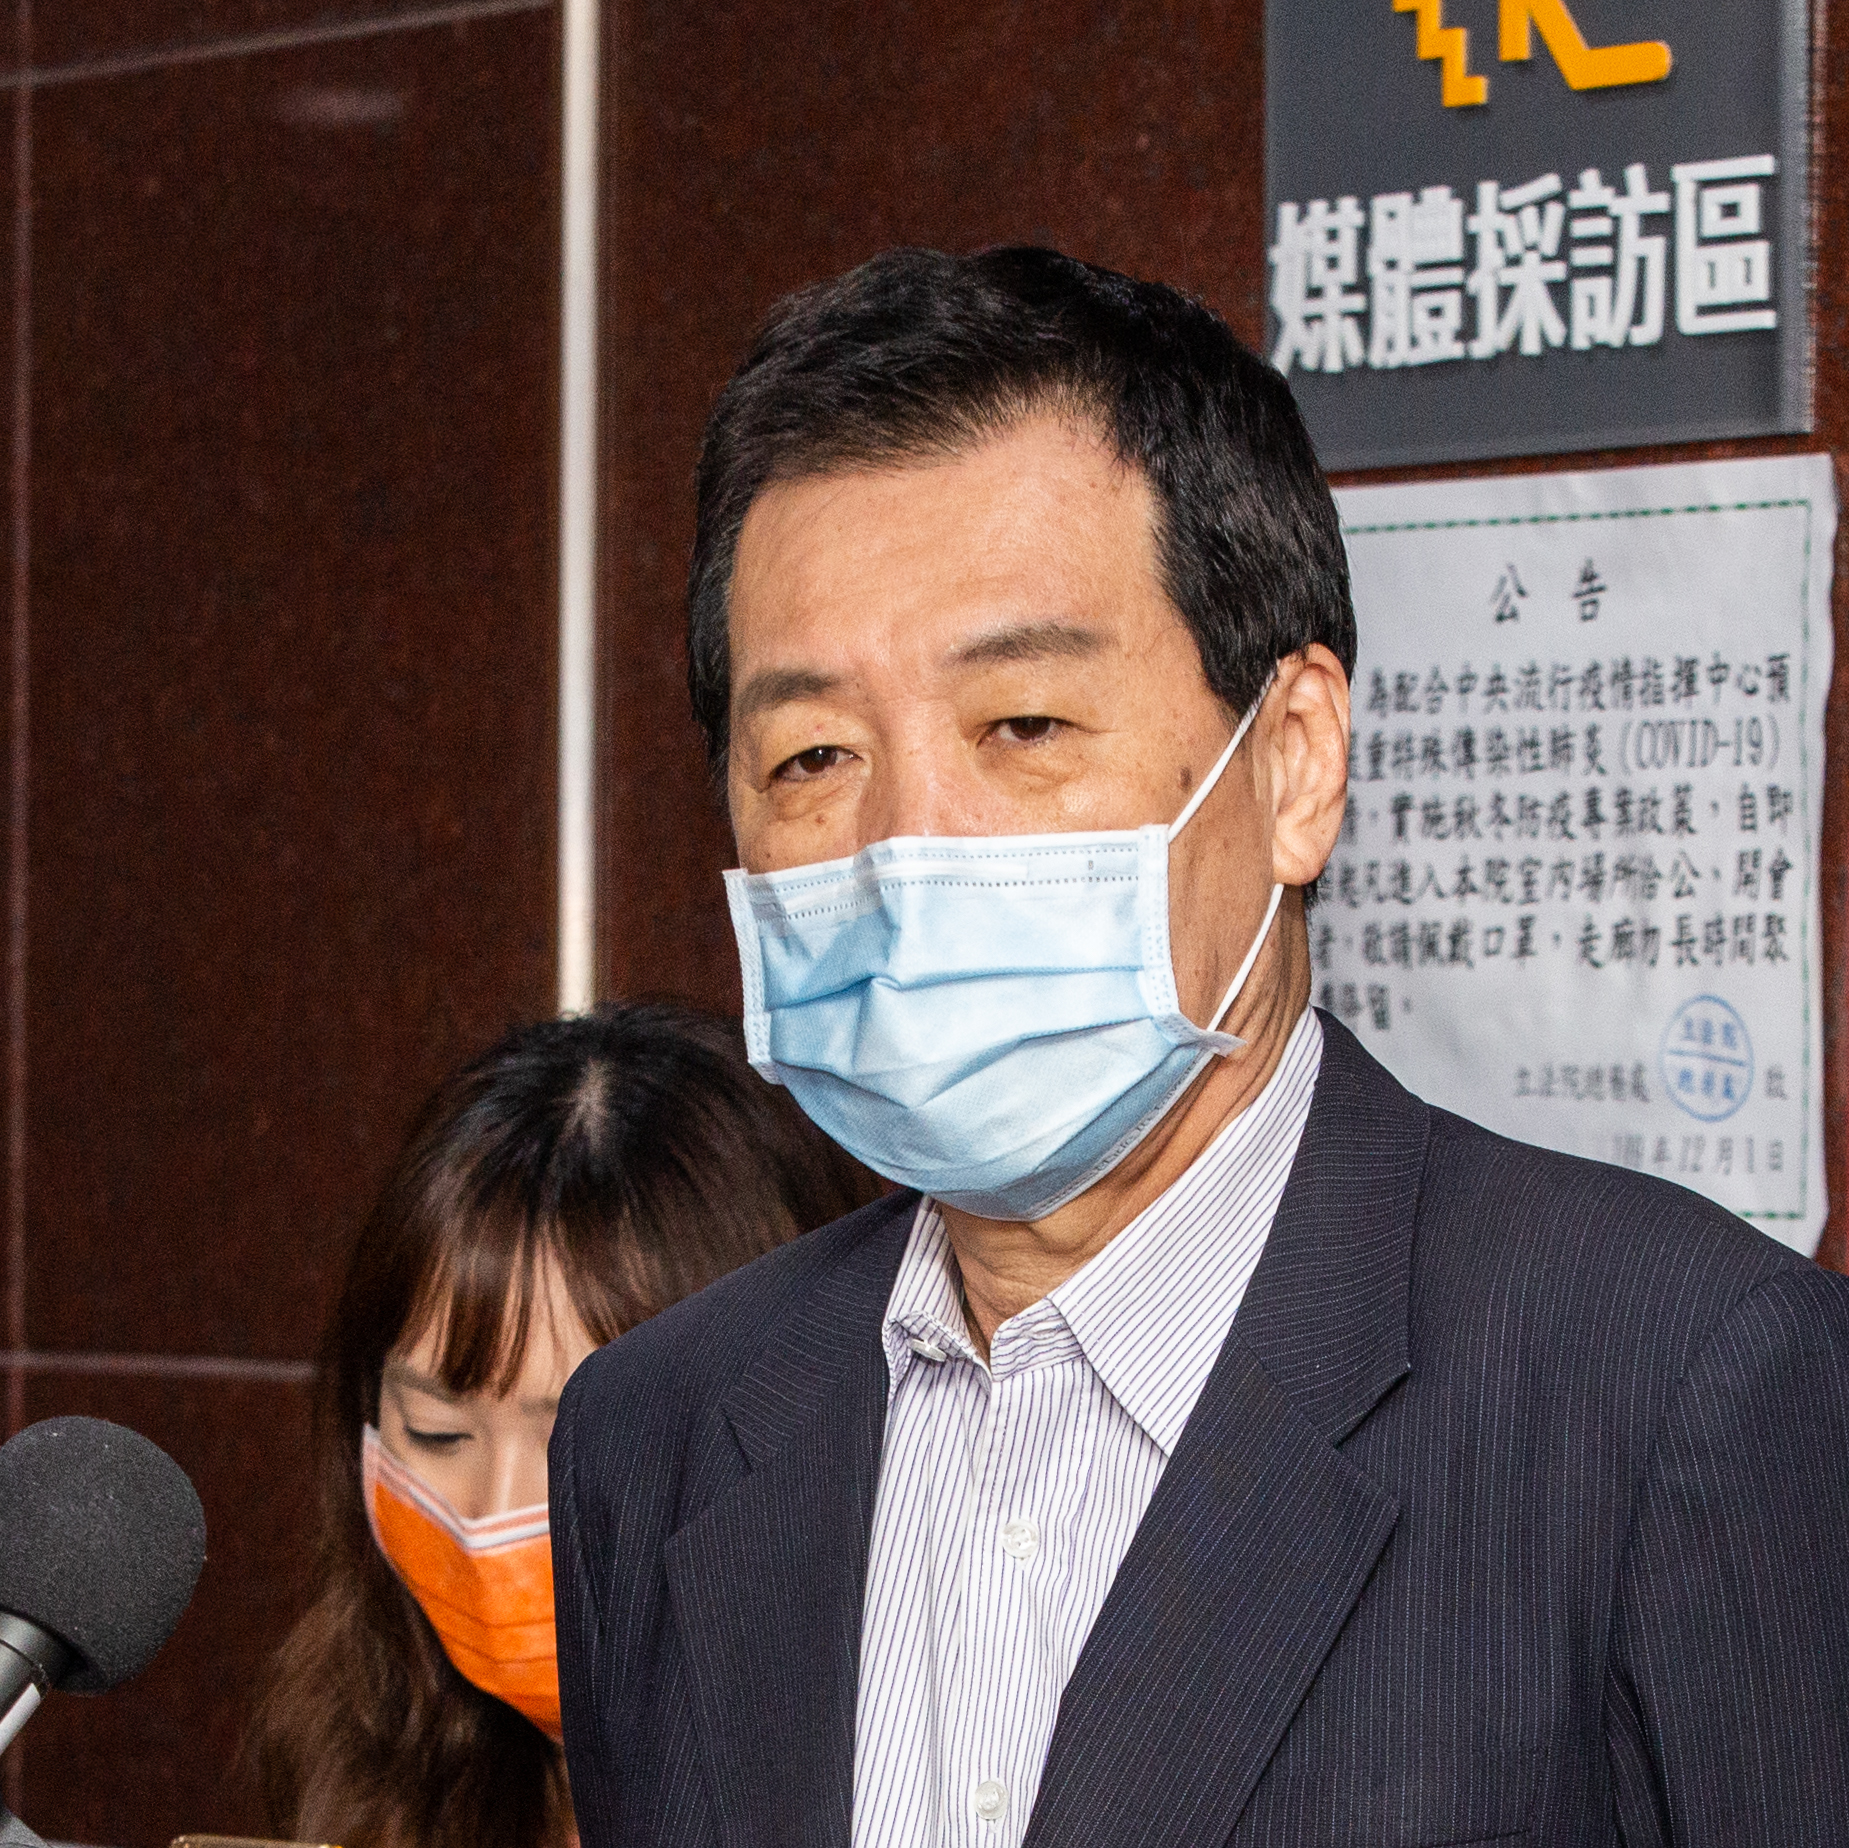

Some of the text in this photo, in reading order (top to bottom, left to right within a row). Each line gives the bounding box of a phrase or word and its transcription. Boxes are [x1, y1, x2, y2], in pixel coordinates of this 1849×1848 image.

[1270, 155, 1777, 376] 媒體採訪區
[1490, 556, 1608, 625] 公告
